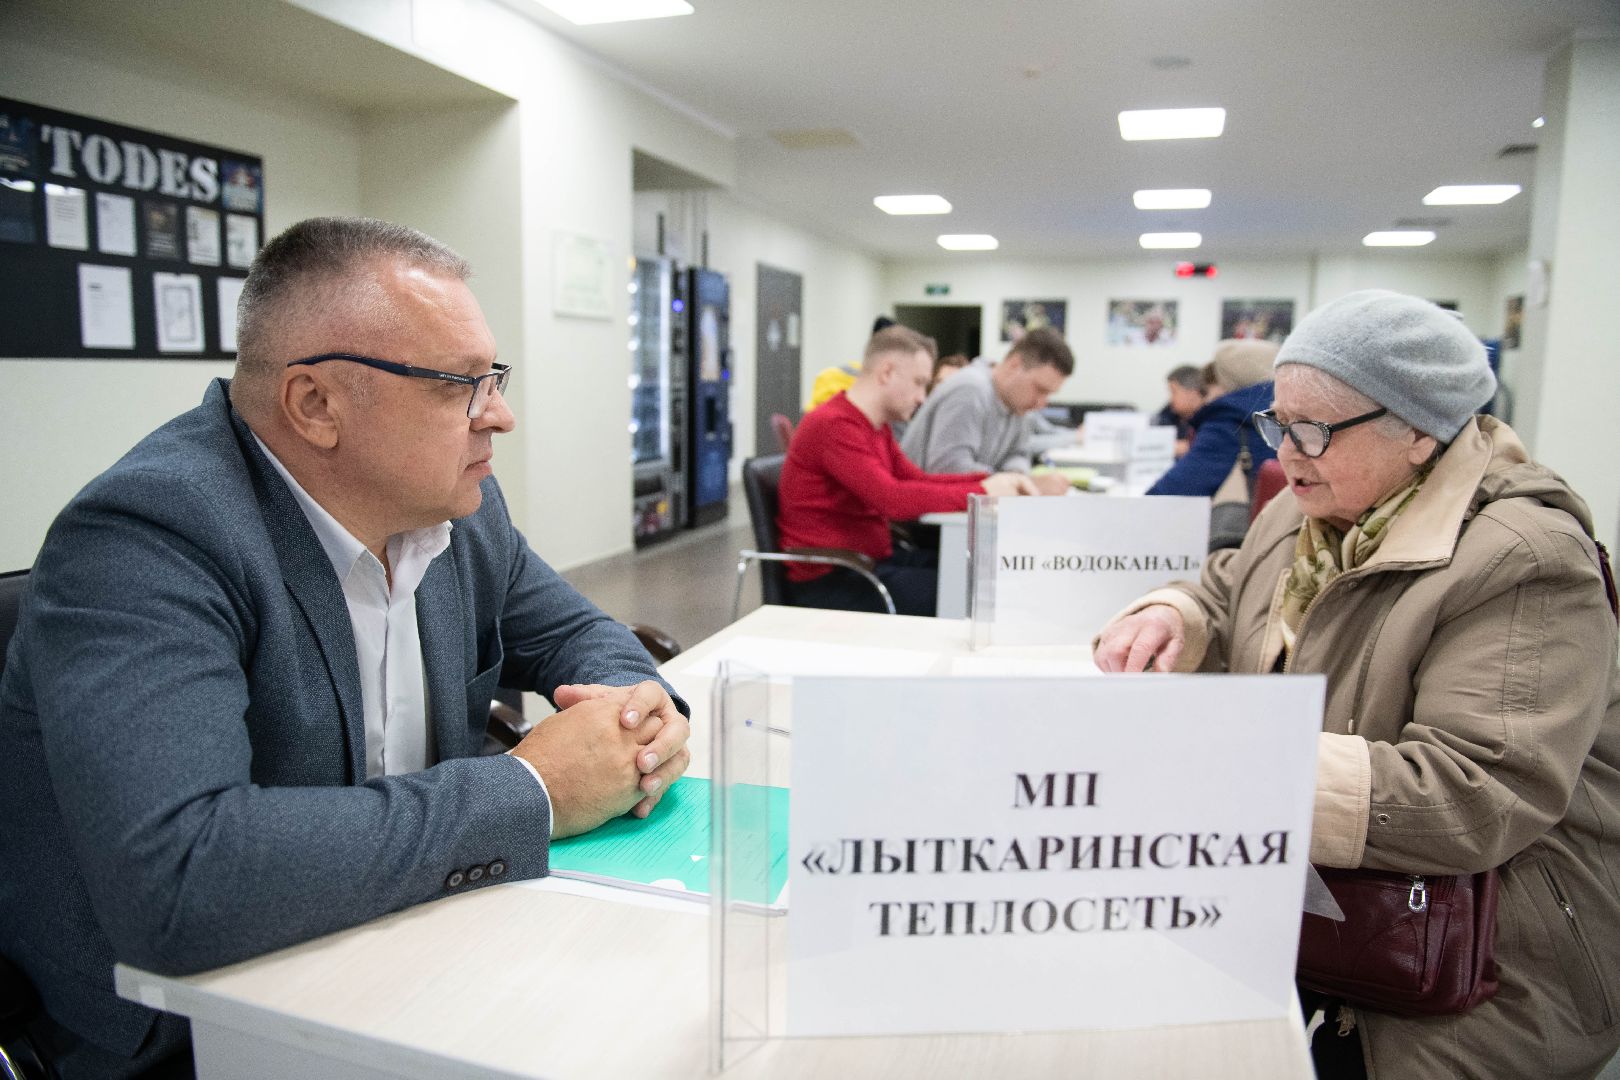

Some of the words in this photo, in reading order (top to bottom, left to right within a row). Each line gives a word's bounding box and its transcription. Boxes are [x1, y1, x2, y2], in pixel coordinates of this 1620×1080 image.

[40, 124, 221, 203] TODES
[1001, 555, 1035, 570] МП
[1042, 555, 1200, 573] «ВОДОКАНАЛ»
[1012, 771, 1100, 809] МП
[801, 830, 1292, 875] «ЛЫТКАРИНСКАЯ
[869, 895, 1223, 937] ТЕПЛОСЕТЬ»
